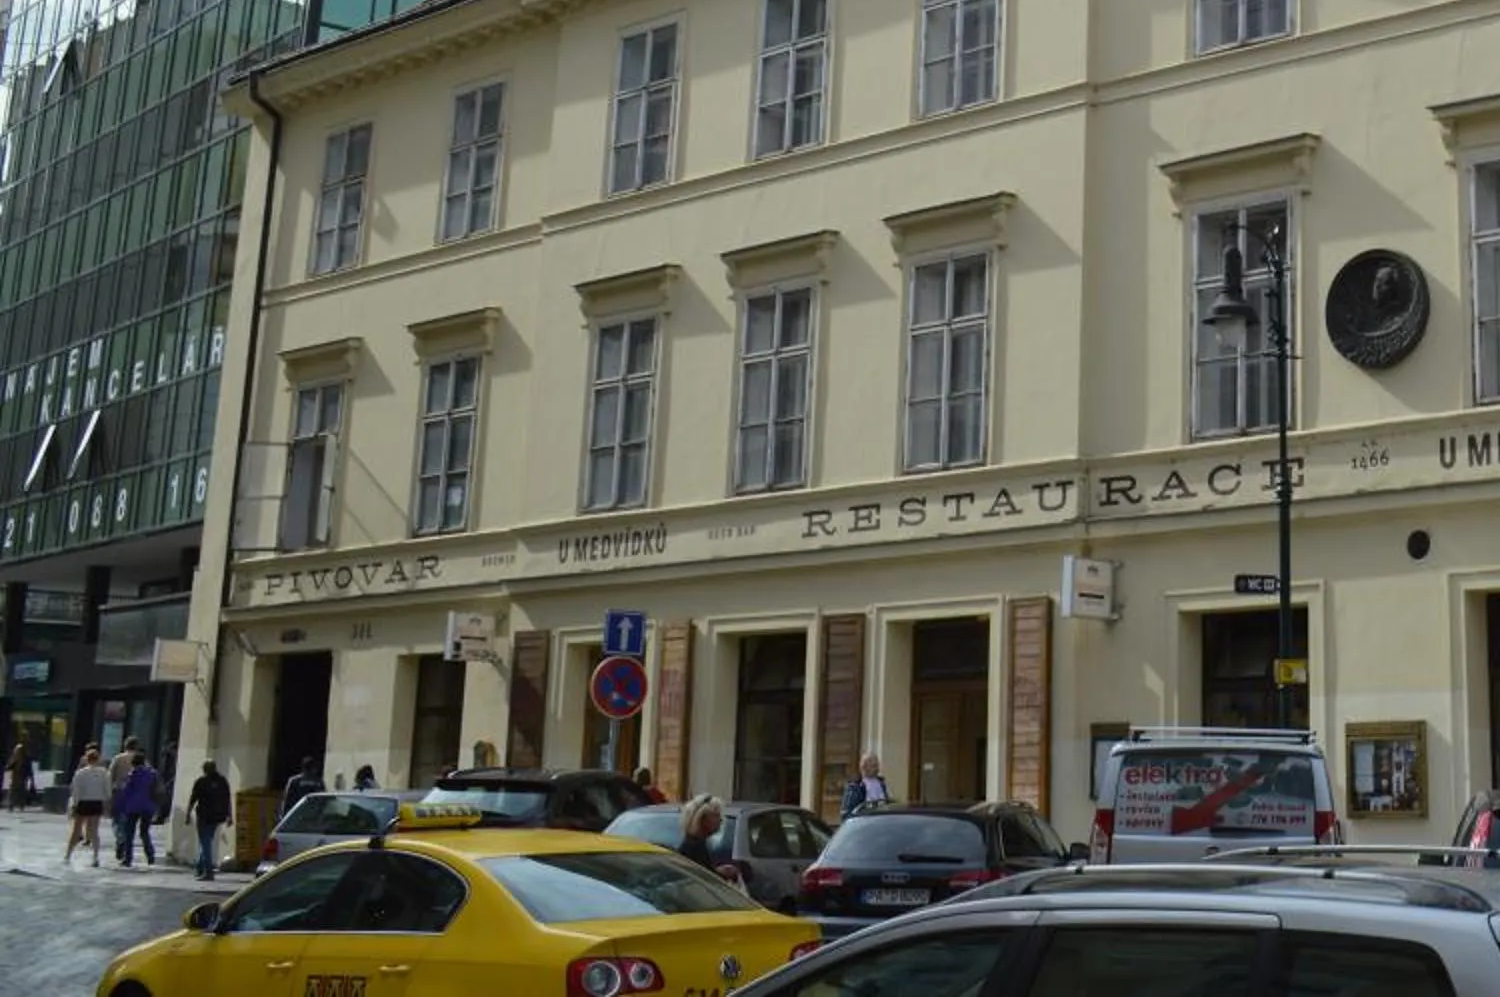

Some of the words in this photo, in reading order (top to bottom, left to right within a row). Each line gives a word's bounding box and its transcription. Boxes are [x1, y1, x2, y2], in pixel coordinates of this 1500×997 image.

[1439, 436, 1458, 470] U
[558, 538, 570, 564] U
[573, 521, 668, 563] MEDVÍDKŮ
[263, 555, 444, 597] PIVOVAR
